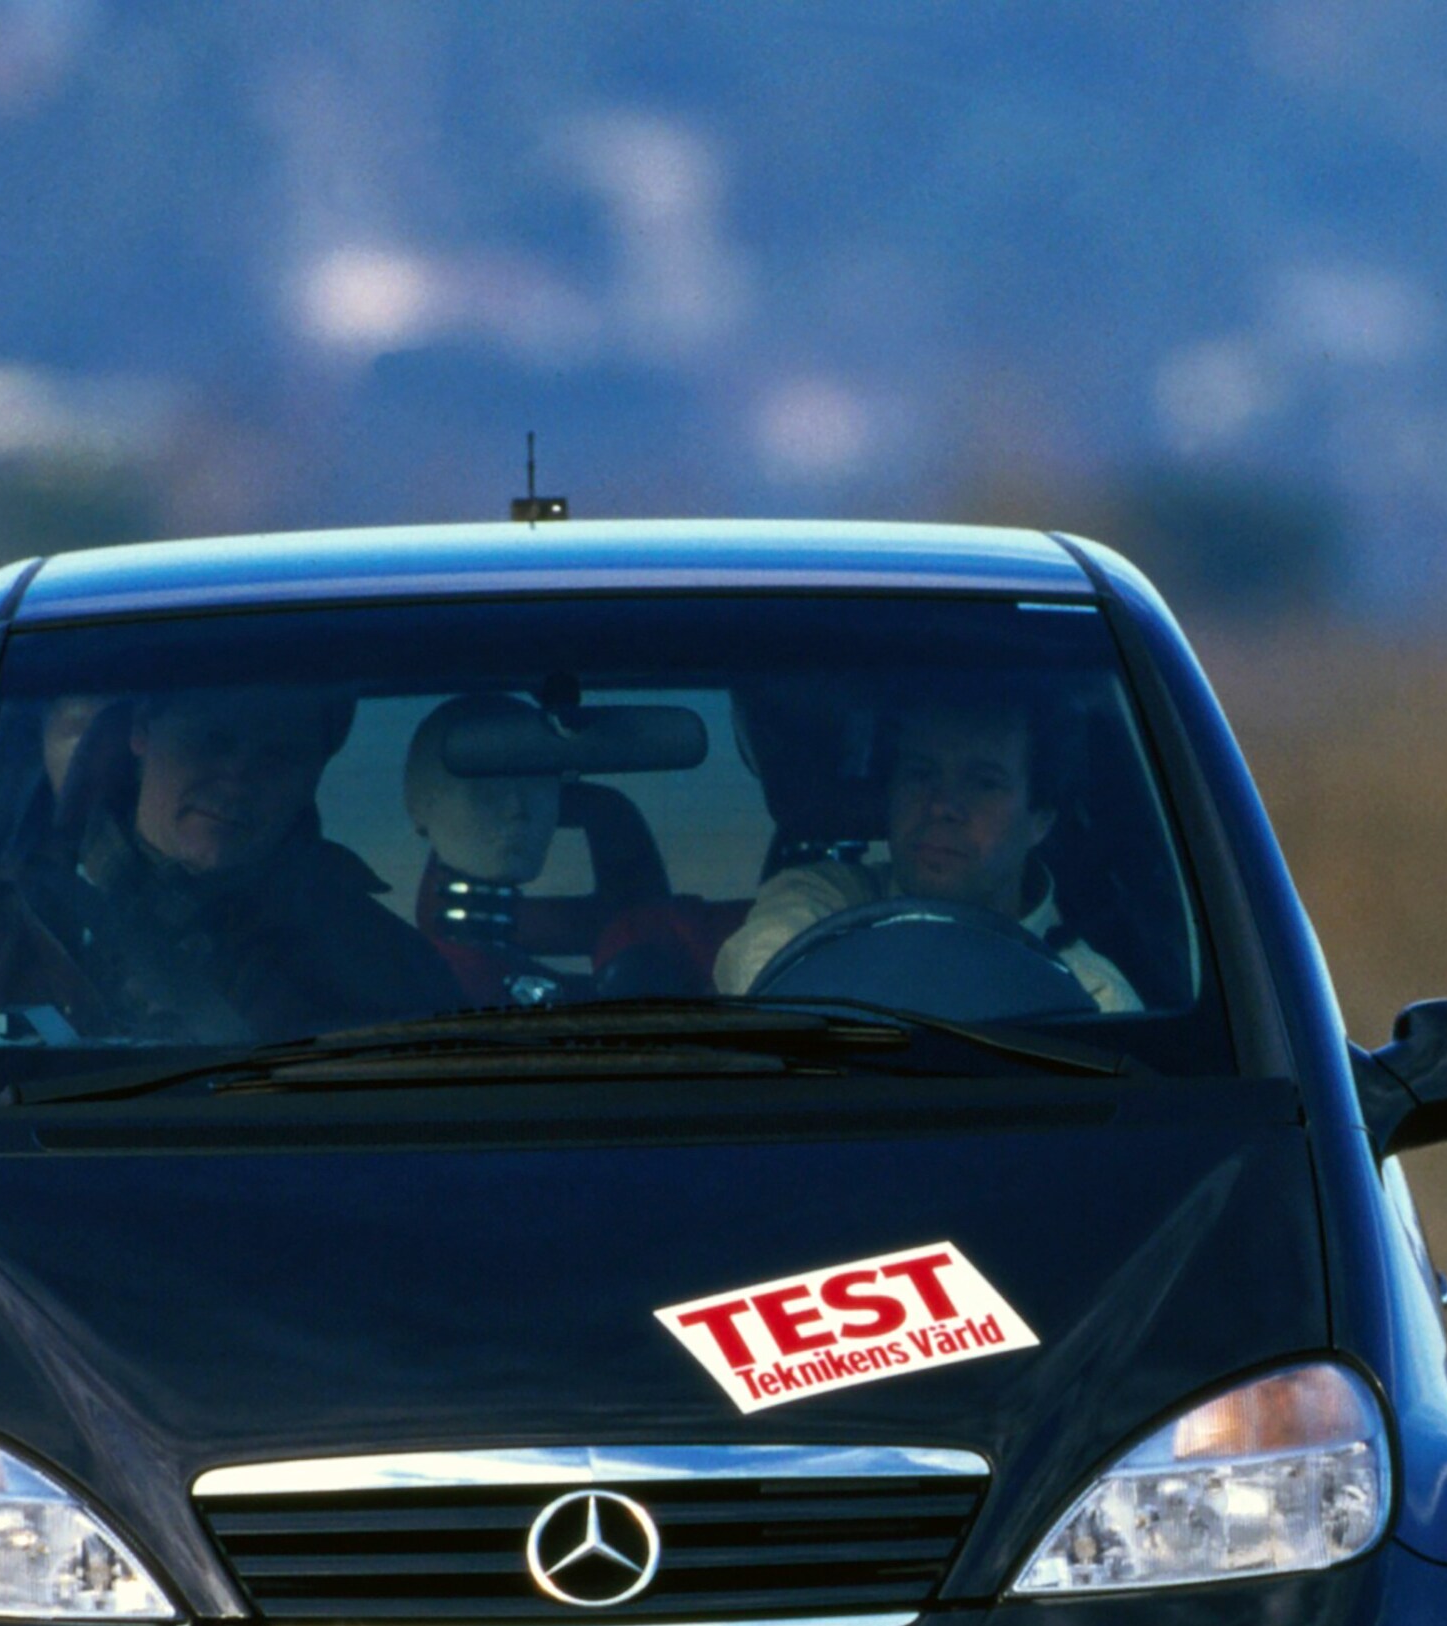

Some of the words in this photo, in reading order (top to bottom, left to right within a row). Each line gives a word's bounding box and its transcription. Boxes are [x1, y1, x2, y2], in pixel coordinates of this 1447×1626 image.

[677, 1252, 959, 1370] TEST
[735, 1339, 911, 1400] Teknikens
[906, 1313, 1006, 1360] Värld
